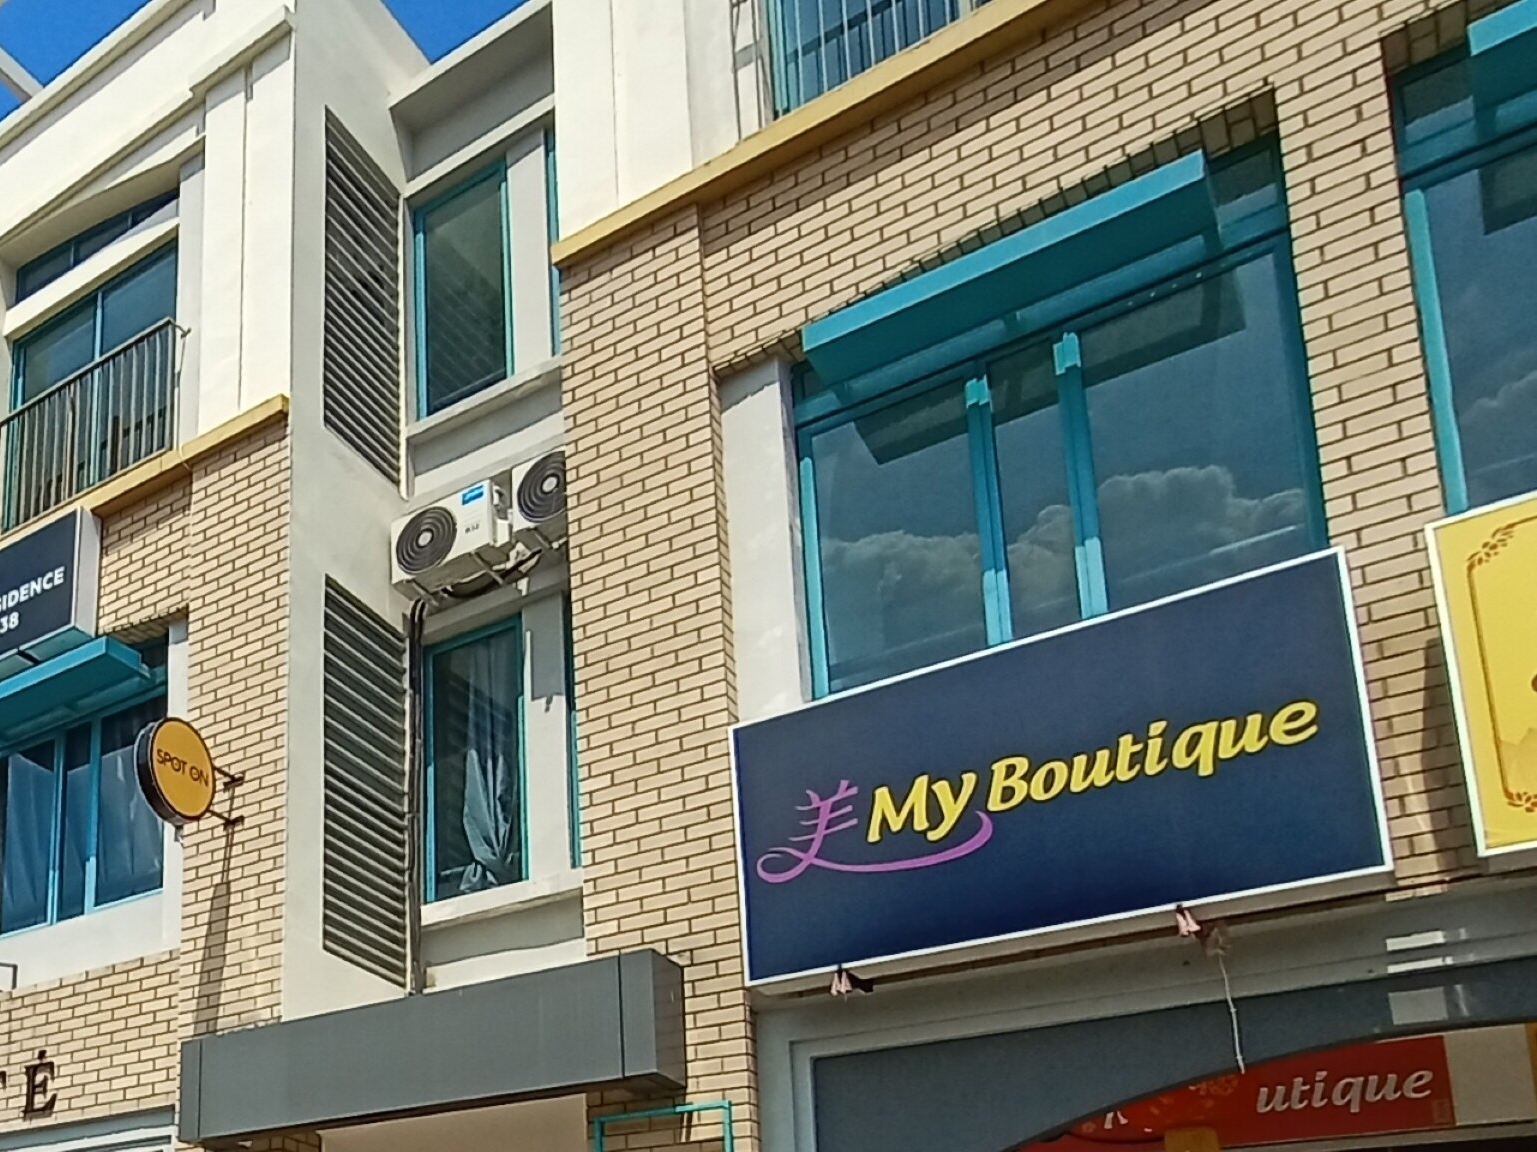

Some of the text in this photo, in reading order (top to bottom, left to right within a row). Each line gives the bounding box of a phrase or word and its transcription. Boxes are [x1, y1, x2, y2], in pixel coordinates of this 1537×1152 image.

[156, 748, 209, 787] SPOT ON
[866, 698, 1319, 843] My Boutique
[1256, 1069, 1434, 1113] utique
